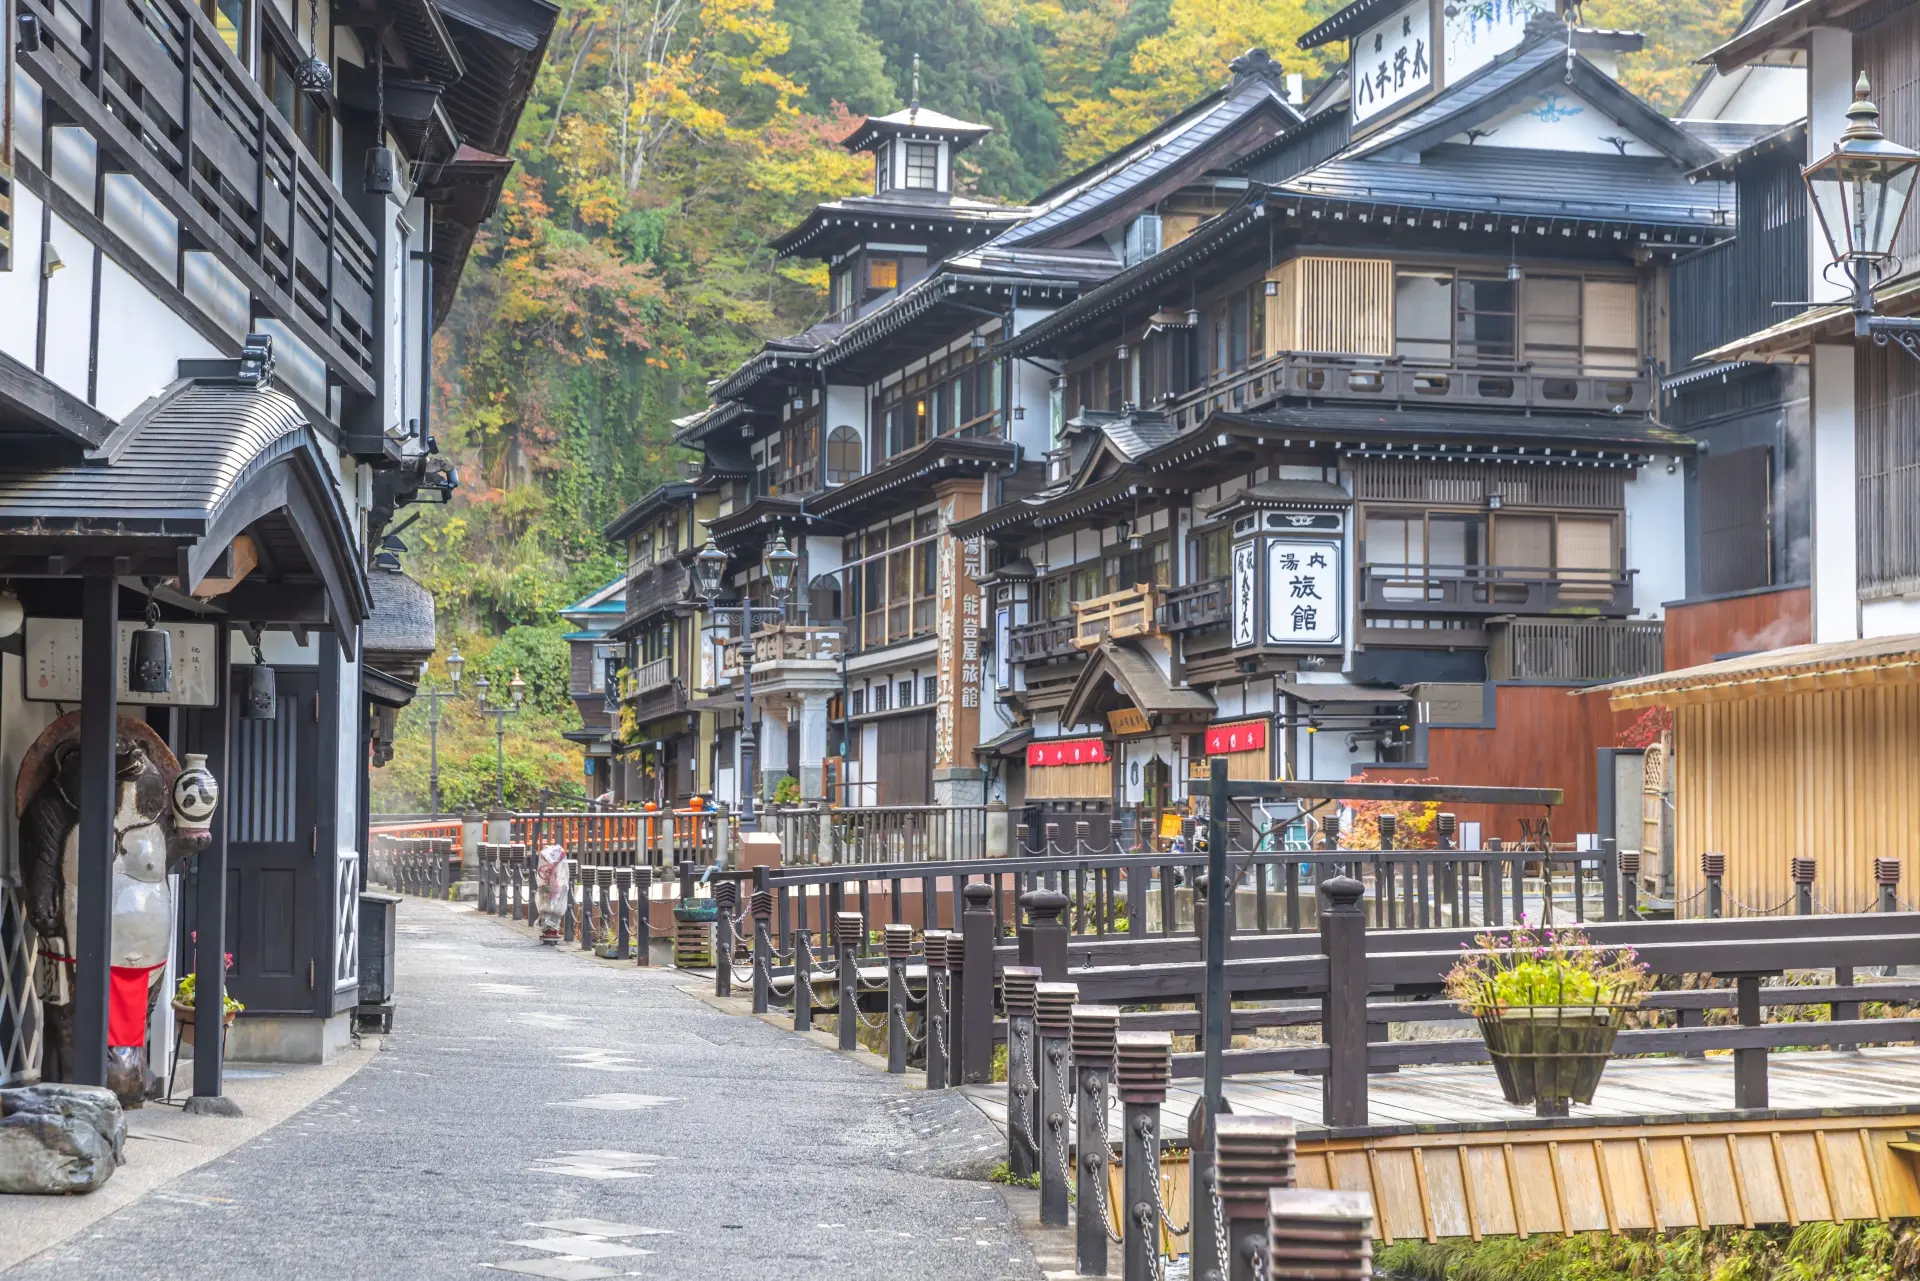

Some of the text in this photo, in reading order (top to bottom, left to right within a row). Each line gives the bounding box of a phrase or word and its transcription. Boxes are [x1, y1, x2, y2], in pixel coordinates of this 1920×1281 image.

[1288, 575, 1322, 632] 旅館
[962, 593, 979, 708] 能登屋旅館
